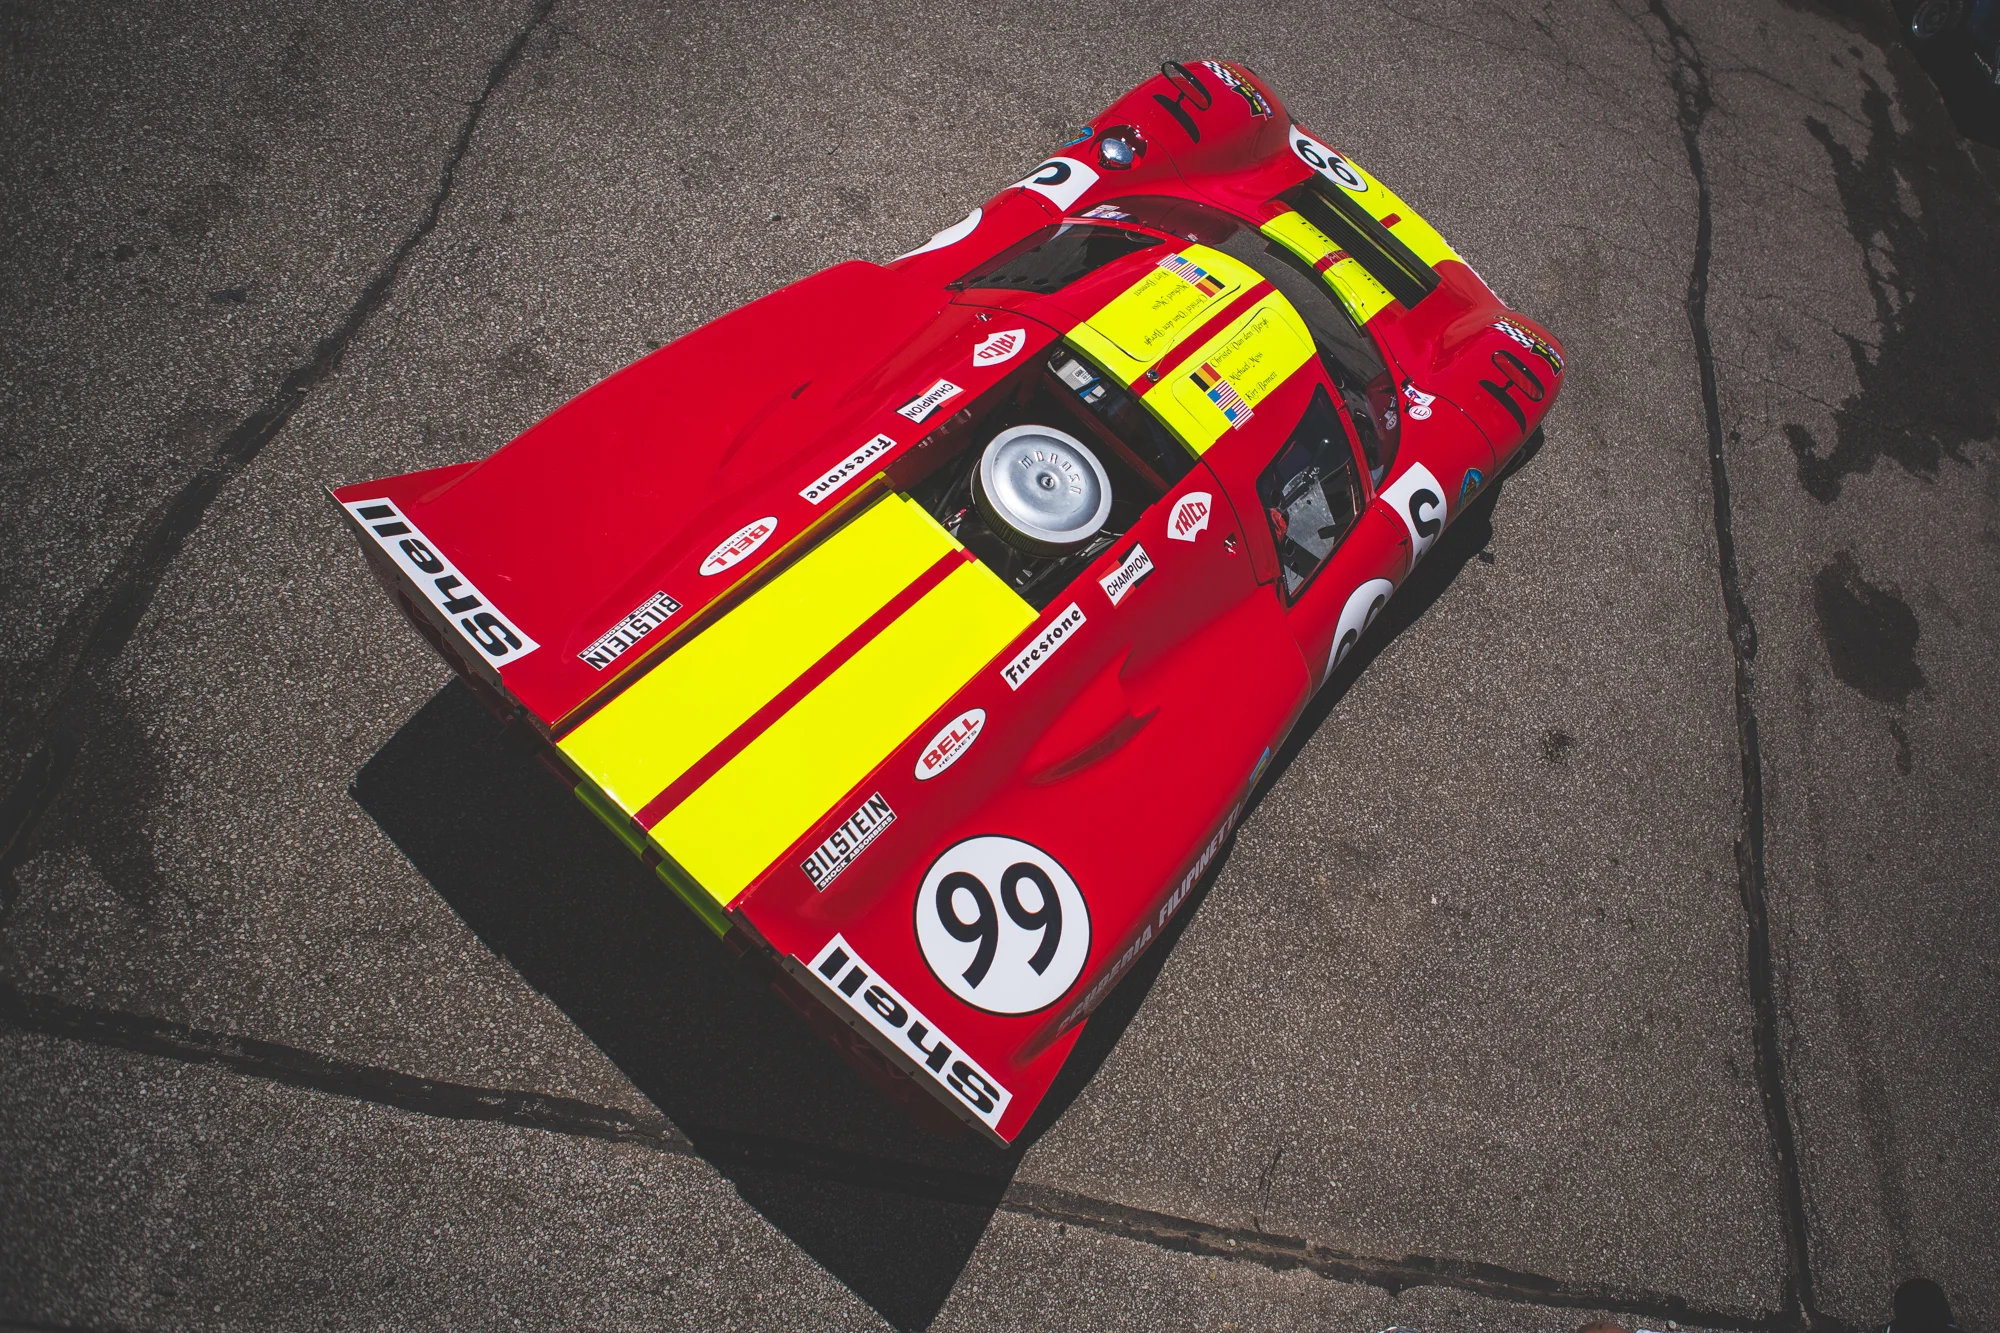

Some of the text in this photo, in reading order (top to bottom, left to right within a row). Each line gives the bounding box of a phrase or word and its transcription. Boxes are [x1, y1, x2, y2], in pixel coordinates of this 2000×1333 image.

[976, 332, 1016, 360] TRICO
[904, 383, 954, 418] CHAMPION
[807, 436, 892, 500] Firestone
[707, 524, 770, 567] BELL
[1175, 502, 1208, 536] TRICO
[356, 504, 523, 657] Shell
[1106, 553, 1149, 597] CHAMPION
[582, 594, 662, 656] SHOCK ABSORBERS
[585, 595, 682, 670] BILSTEIN
[1005, 609, 1081, 685] Firestone
[922, 718, 979, 770] BELL
[939, 730, 977, 768] HELMETS
[801, 793, 890, 883] BILSTEIN
[820, 816, 892, 887] SHOCK ABSORBERS
[1158, 802, 1241, 928] FILIPINETTI
[935, 862, 1063, 990] 99
[818, 946, 1000, 1115] Shell
